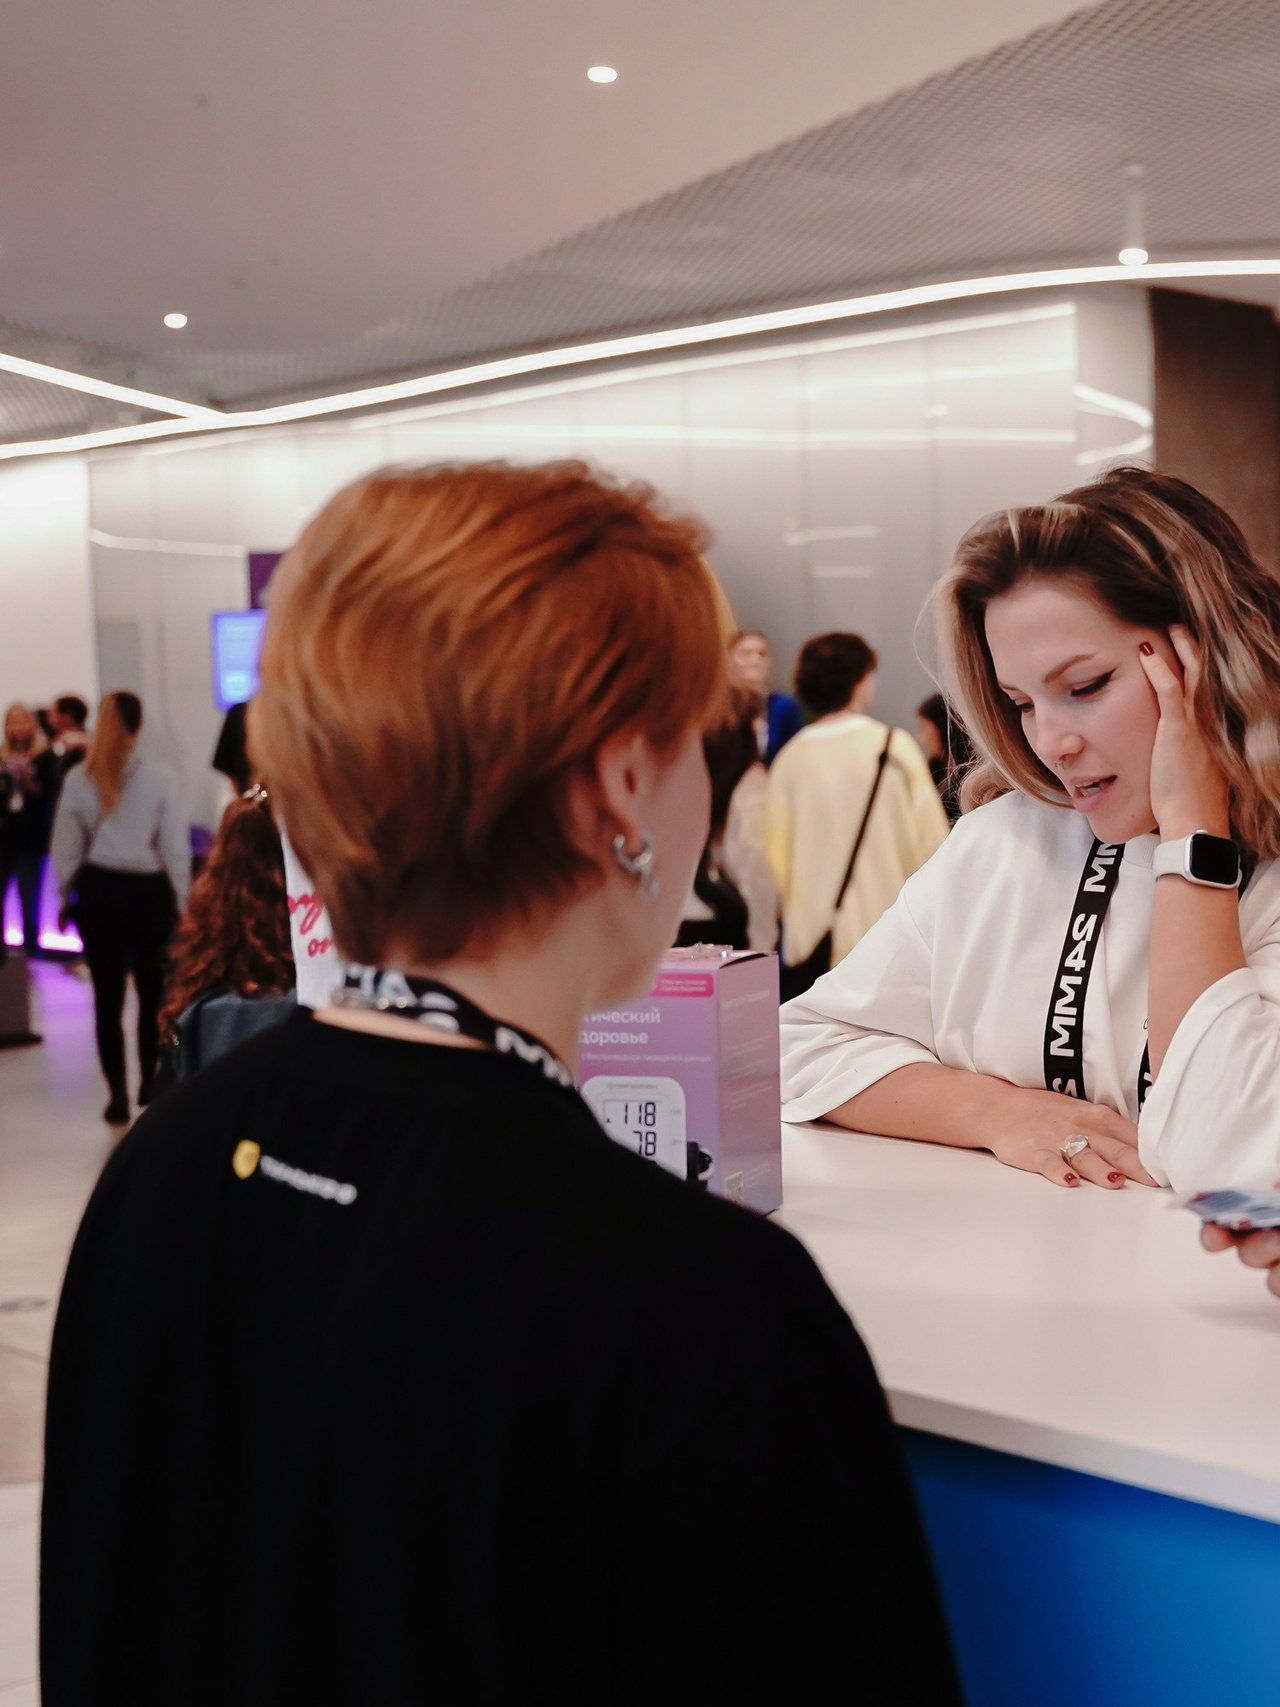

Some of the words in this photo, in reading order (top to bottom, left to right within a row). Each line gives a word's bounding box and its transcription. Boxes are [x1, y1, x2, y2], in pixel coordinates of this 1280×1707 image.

[579, 1031, 649, 1046] доровье
[624, 1102, 657, 1126] 118
[633, 1131, 657, 1156] 78
